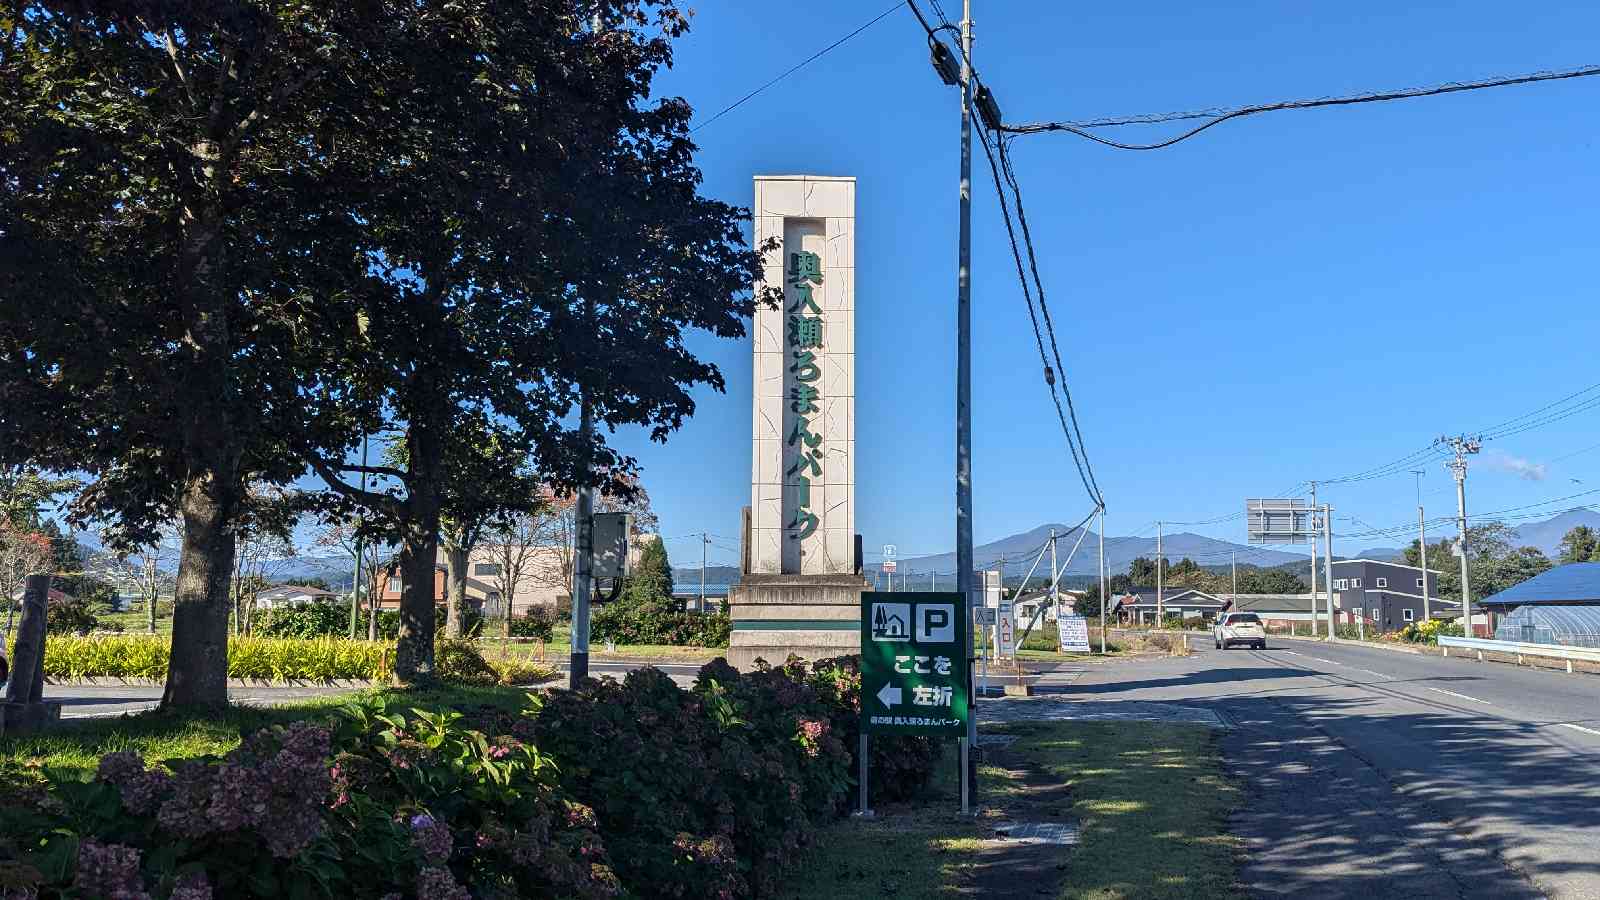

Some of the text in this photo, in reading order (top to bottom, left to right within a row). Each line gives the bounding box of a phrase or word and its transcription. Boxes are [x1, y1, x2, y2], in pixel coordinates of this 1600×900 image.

[788, 250, 824, 538] 奥入瀬ろまんパーク
[924, 609, 949, 637] P
[894, 655, 952, 675] ここを
[912, 685, 953, 707] 左折
